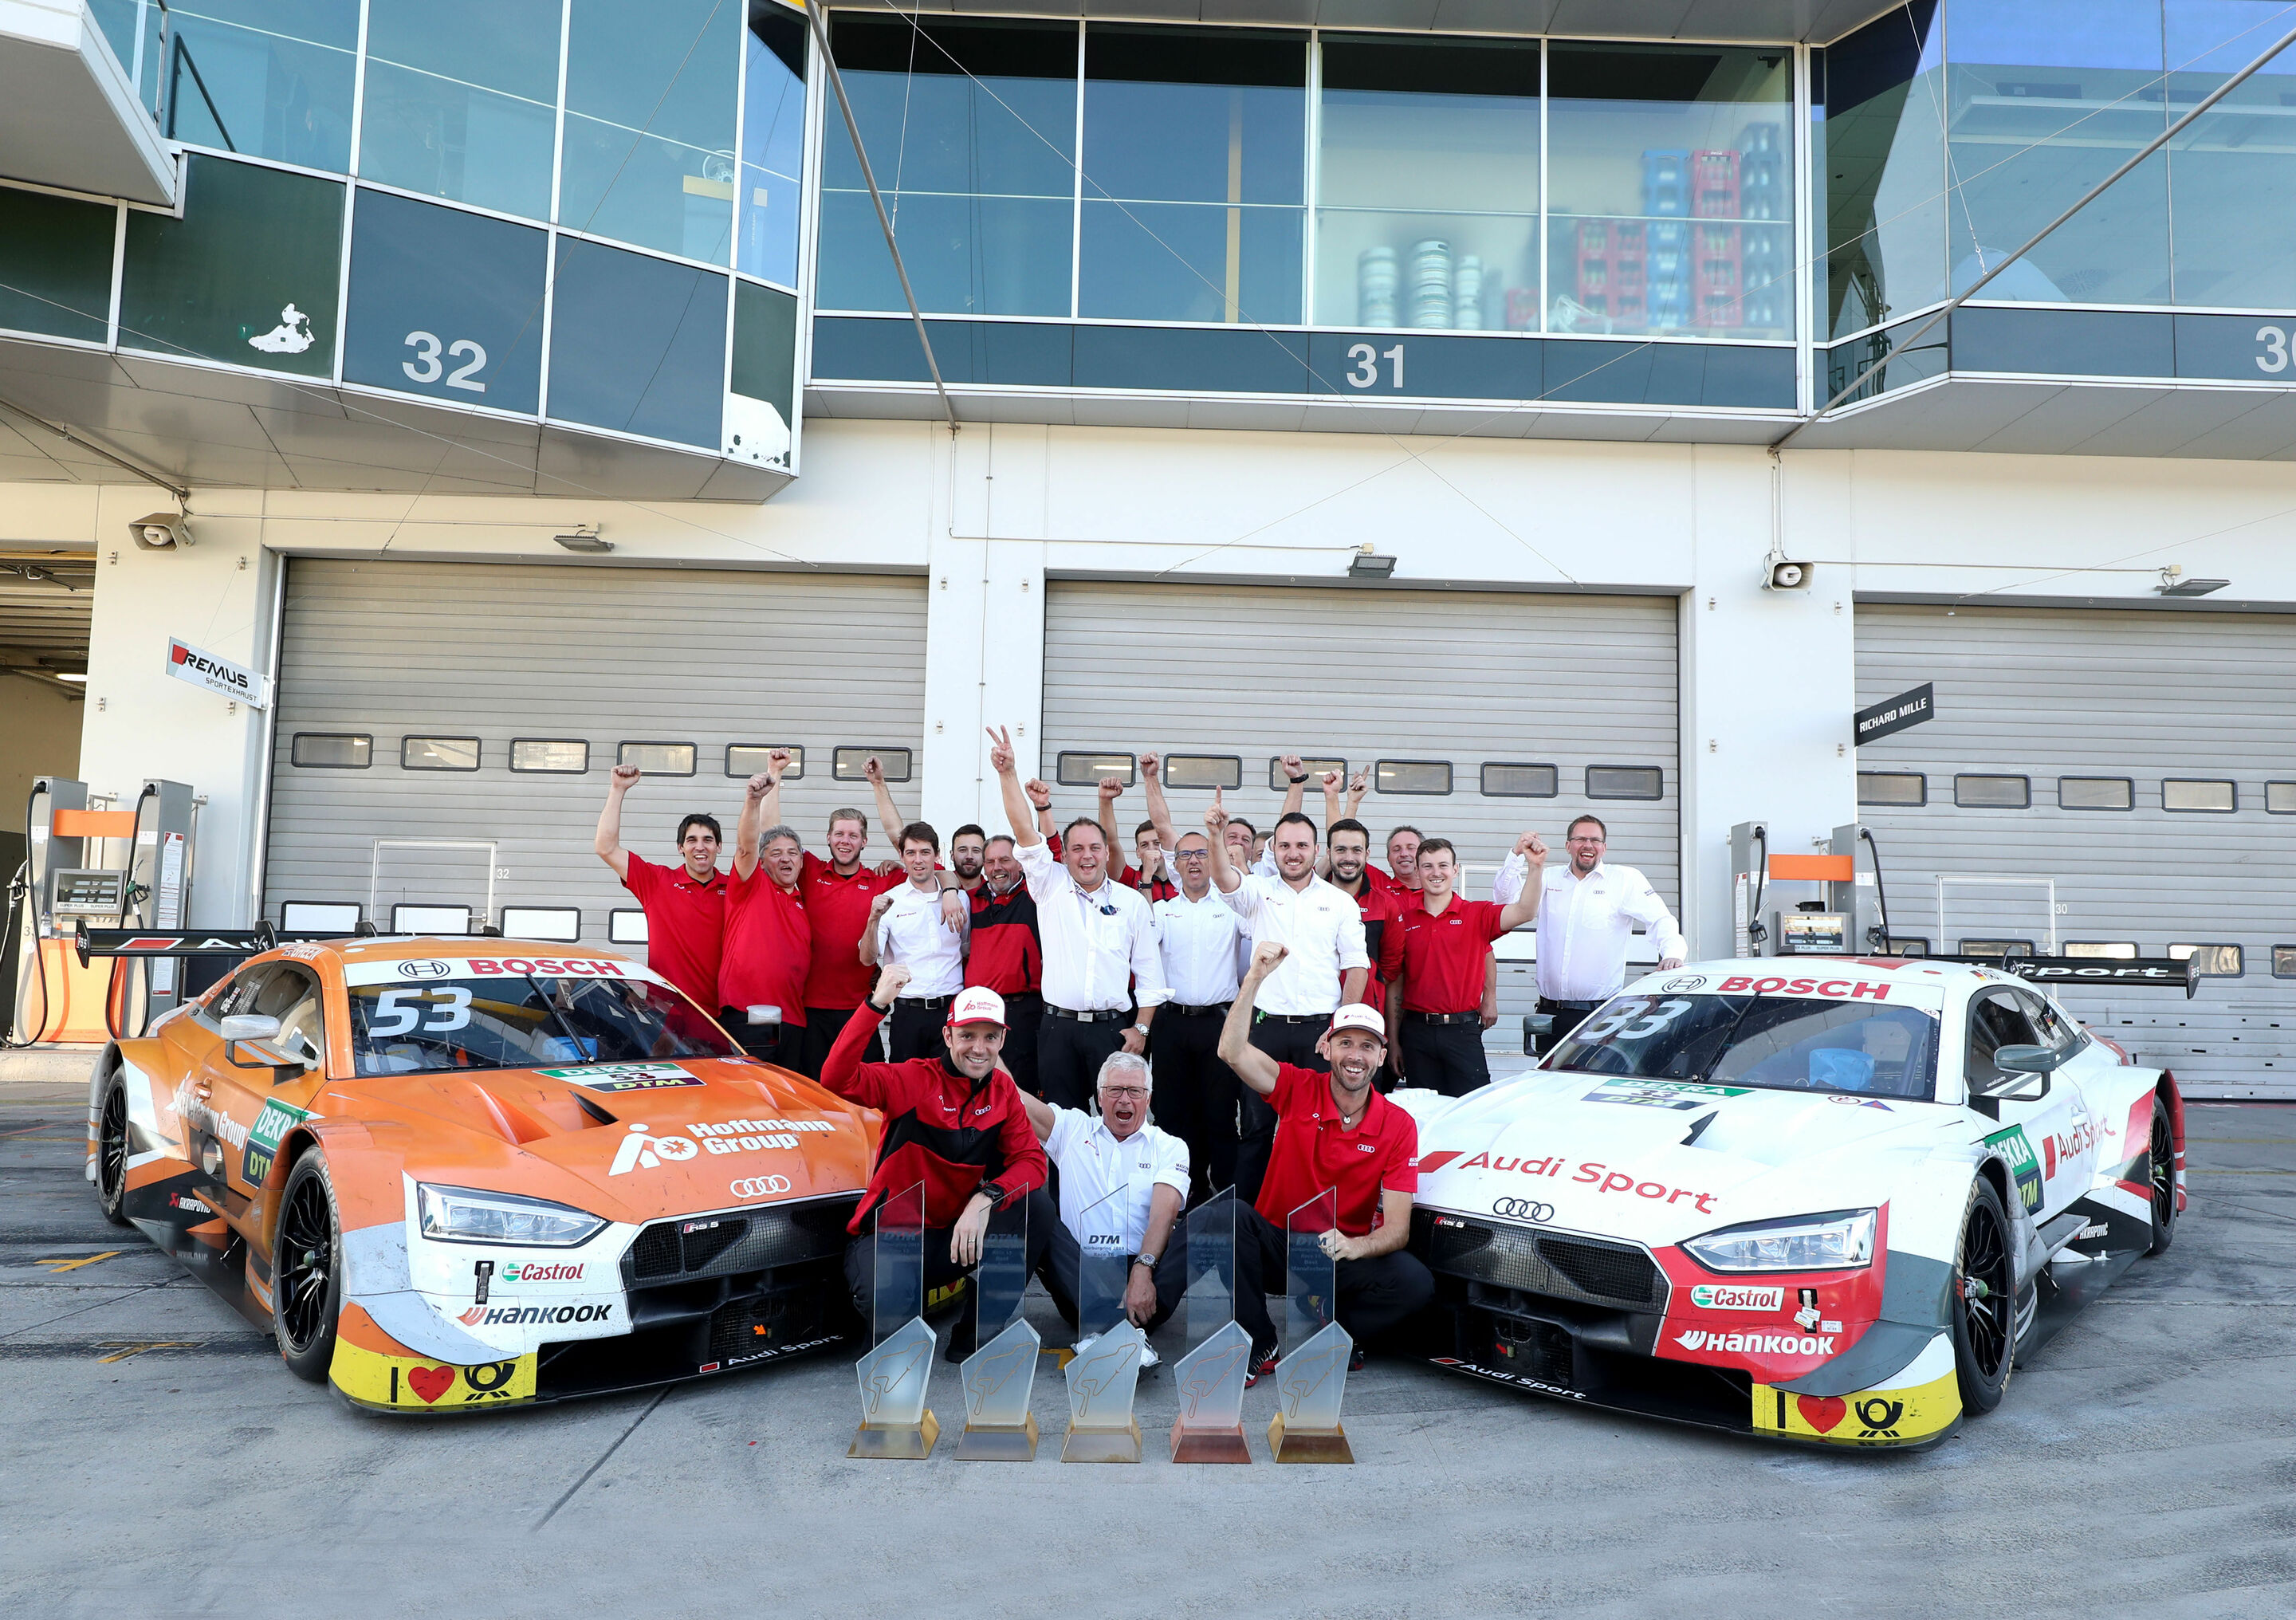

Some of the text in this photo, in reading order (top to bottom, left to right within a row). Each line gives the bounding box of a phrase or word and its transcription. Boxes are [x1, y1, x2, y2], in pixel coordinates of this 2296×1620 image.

[2255, 325, 2296, 373] 3
[402, 331, 487, 393] 32
[1347, 344, 1405, 389] 31
[183, 652, 249, 689] REMUS
[205, 677, 258, 702] SPORTEXHAUST
[1859, 698, 1927, 733] RICHARD MILLE
[497, 868, 509, 879] 32
[2055, 903, 2068, 914] 30
[467, 959, 625, 976] BOSCH
[1717, 976, 1891, 1001] BOSCH
[368, 986, 474, 1038] 53
[1577, 1001, 1693, 1040] 33
[558, 1064, 668, 1076] DEKRA
[608, 1072, 656, 1081] 53
[612, 1079, 686, 1091] DTM
[1619, 1079, 1726, 1095] DEKRA
[1607, 1095, 1683, 1108] DTM
[686, 1119, 836, 1138] Hoffmann
[702, 1132, 800, 1155] Group
[2058, 1127, 2083, 1164] Audi
[1458, 1151, 1718, 1215] Audi Sport
[1088, 1235, 1120, 1244] DTM
[1295, 1237, 1327, 1246] DTM
[521, 1263, 585, 1281] Castrol
[1714, 1288, 1777, 1307] Castrol
[484, 1304, 612, 1325] HANKOOK
[728, 1335, 843, 1366] Audi Sport
[1705, 1333, 1835, 1355] HANKOOK
[1460, 1364, 1586, 1399] Audi Sport
